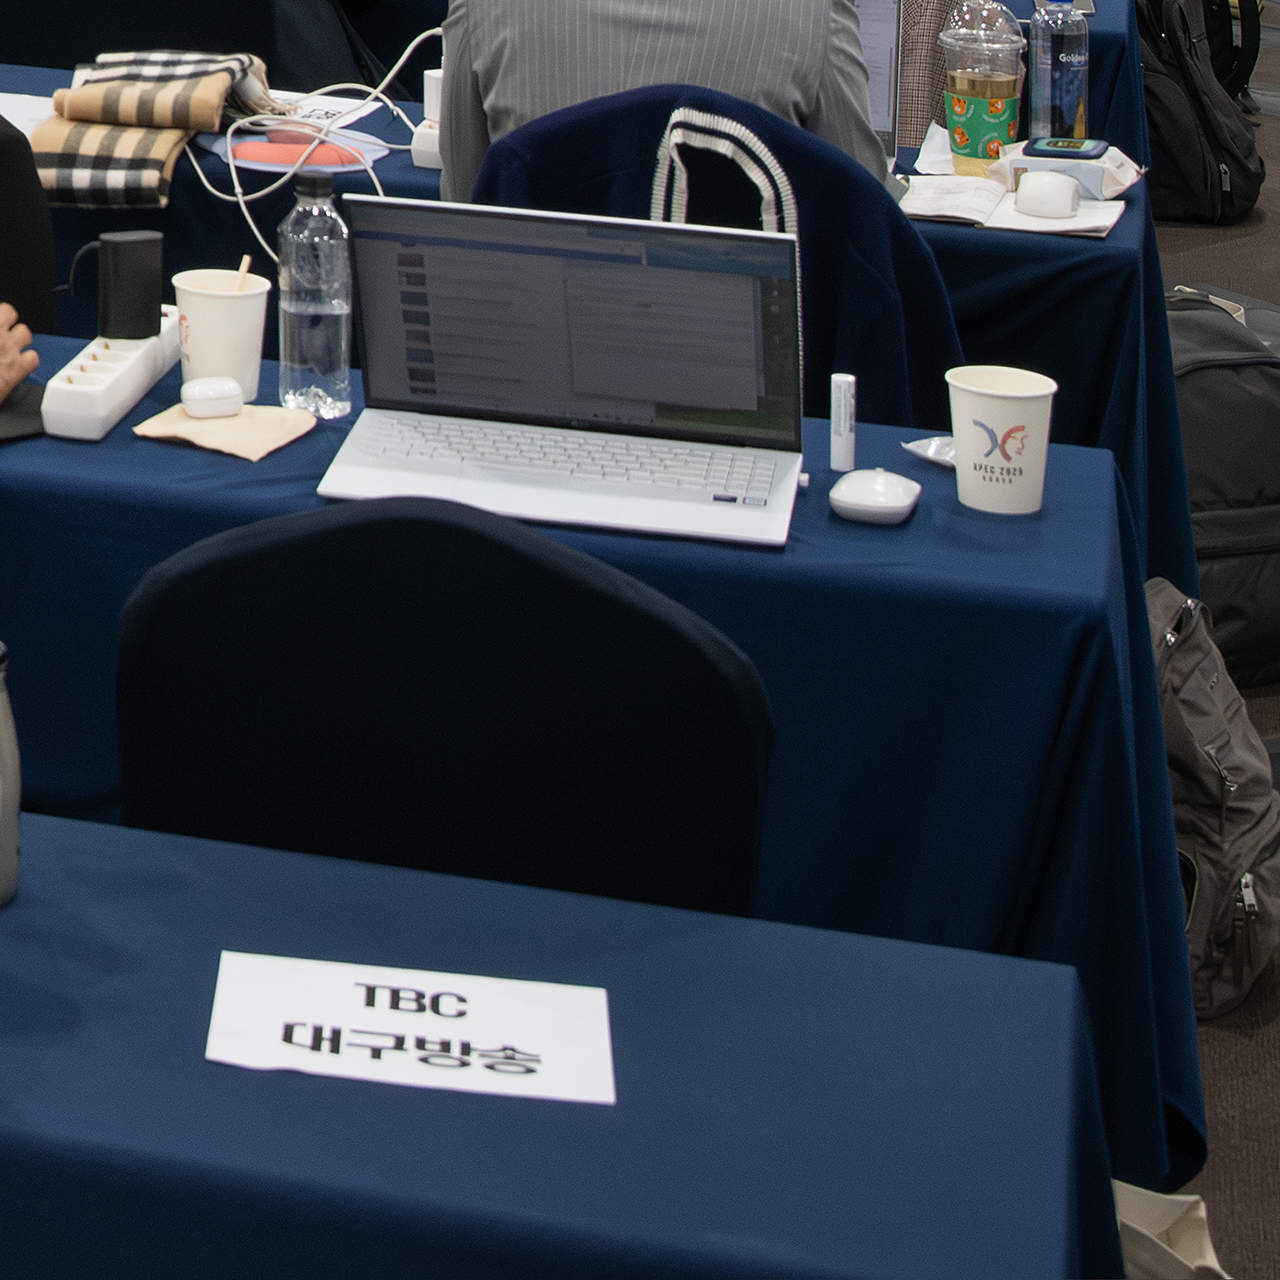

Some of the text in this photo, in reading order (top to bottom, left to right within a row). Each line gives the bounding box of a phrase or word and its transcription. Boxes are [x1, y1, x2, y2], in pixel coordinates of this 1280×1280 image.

[973, 462, 995, 475] APEC
[354, 981, 468, 1019] TBC
[281, 1020, 542, 1075] 대구방송
